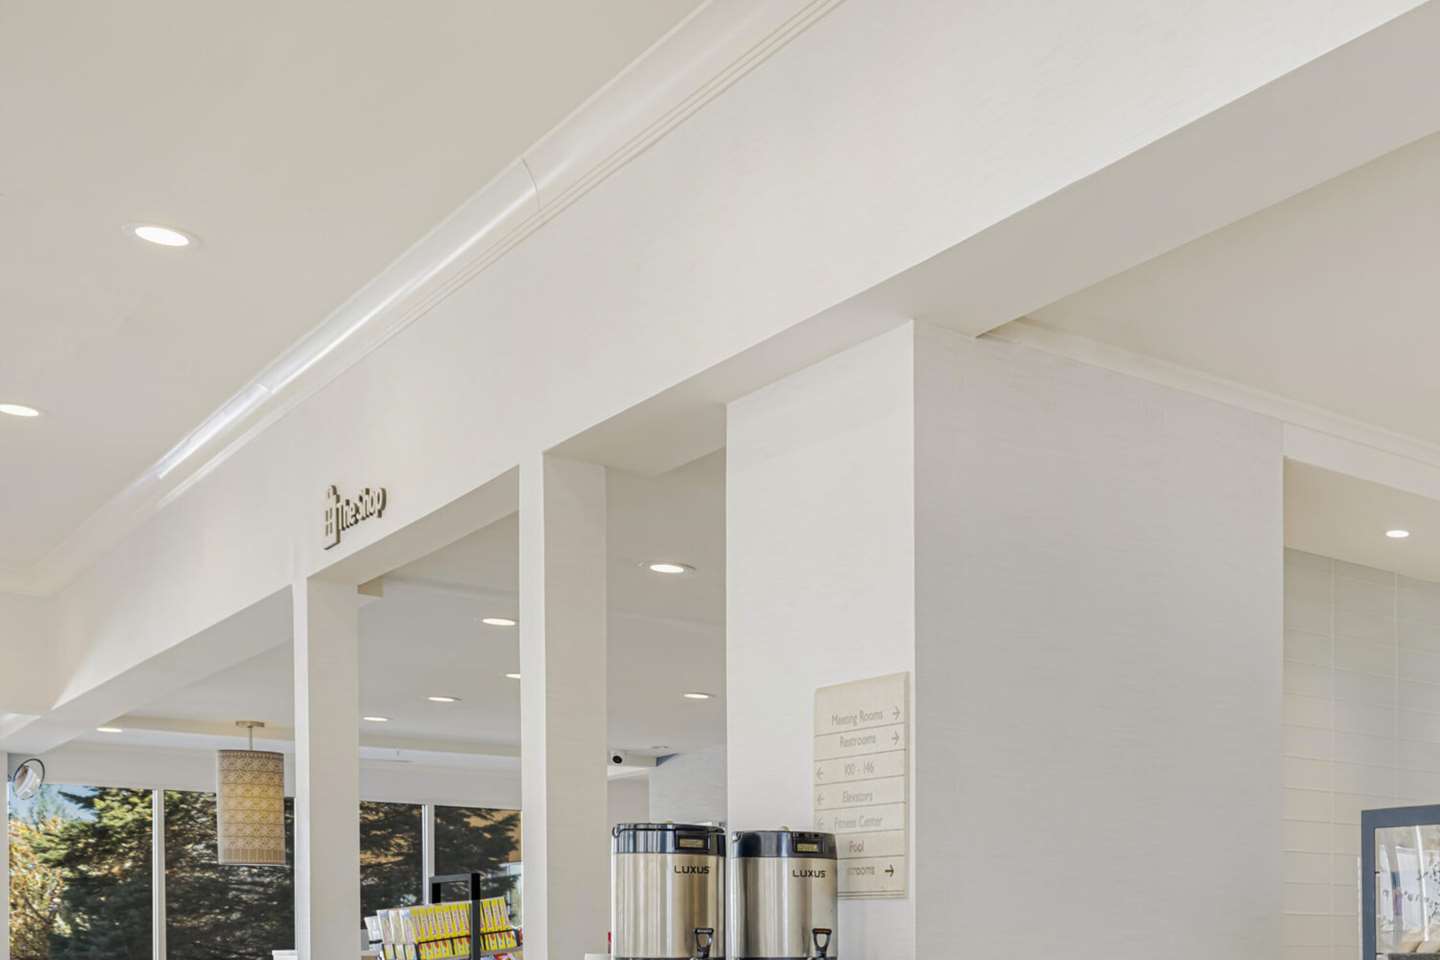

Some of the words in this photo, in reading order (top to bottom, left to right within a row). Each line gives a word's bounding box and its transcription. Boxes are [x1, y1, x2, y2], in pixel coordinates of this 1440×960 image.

[831, 711, 858, 727] Meeting
[859, 708, 884, 722] Rooms
[840, 735, 877, 747] Restrooms
[849, 840, 864, 853] Pool
[674, 865, 710, 875] LUXUS
[792, 869, 826, 879] LUXUS
